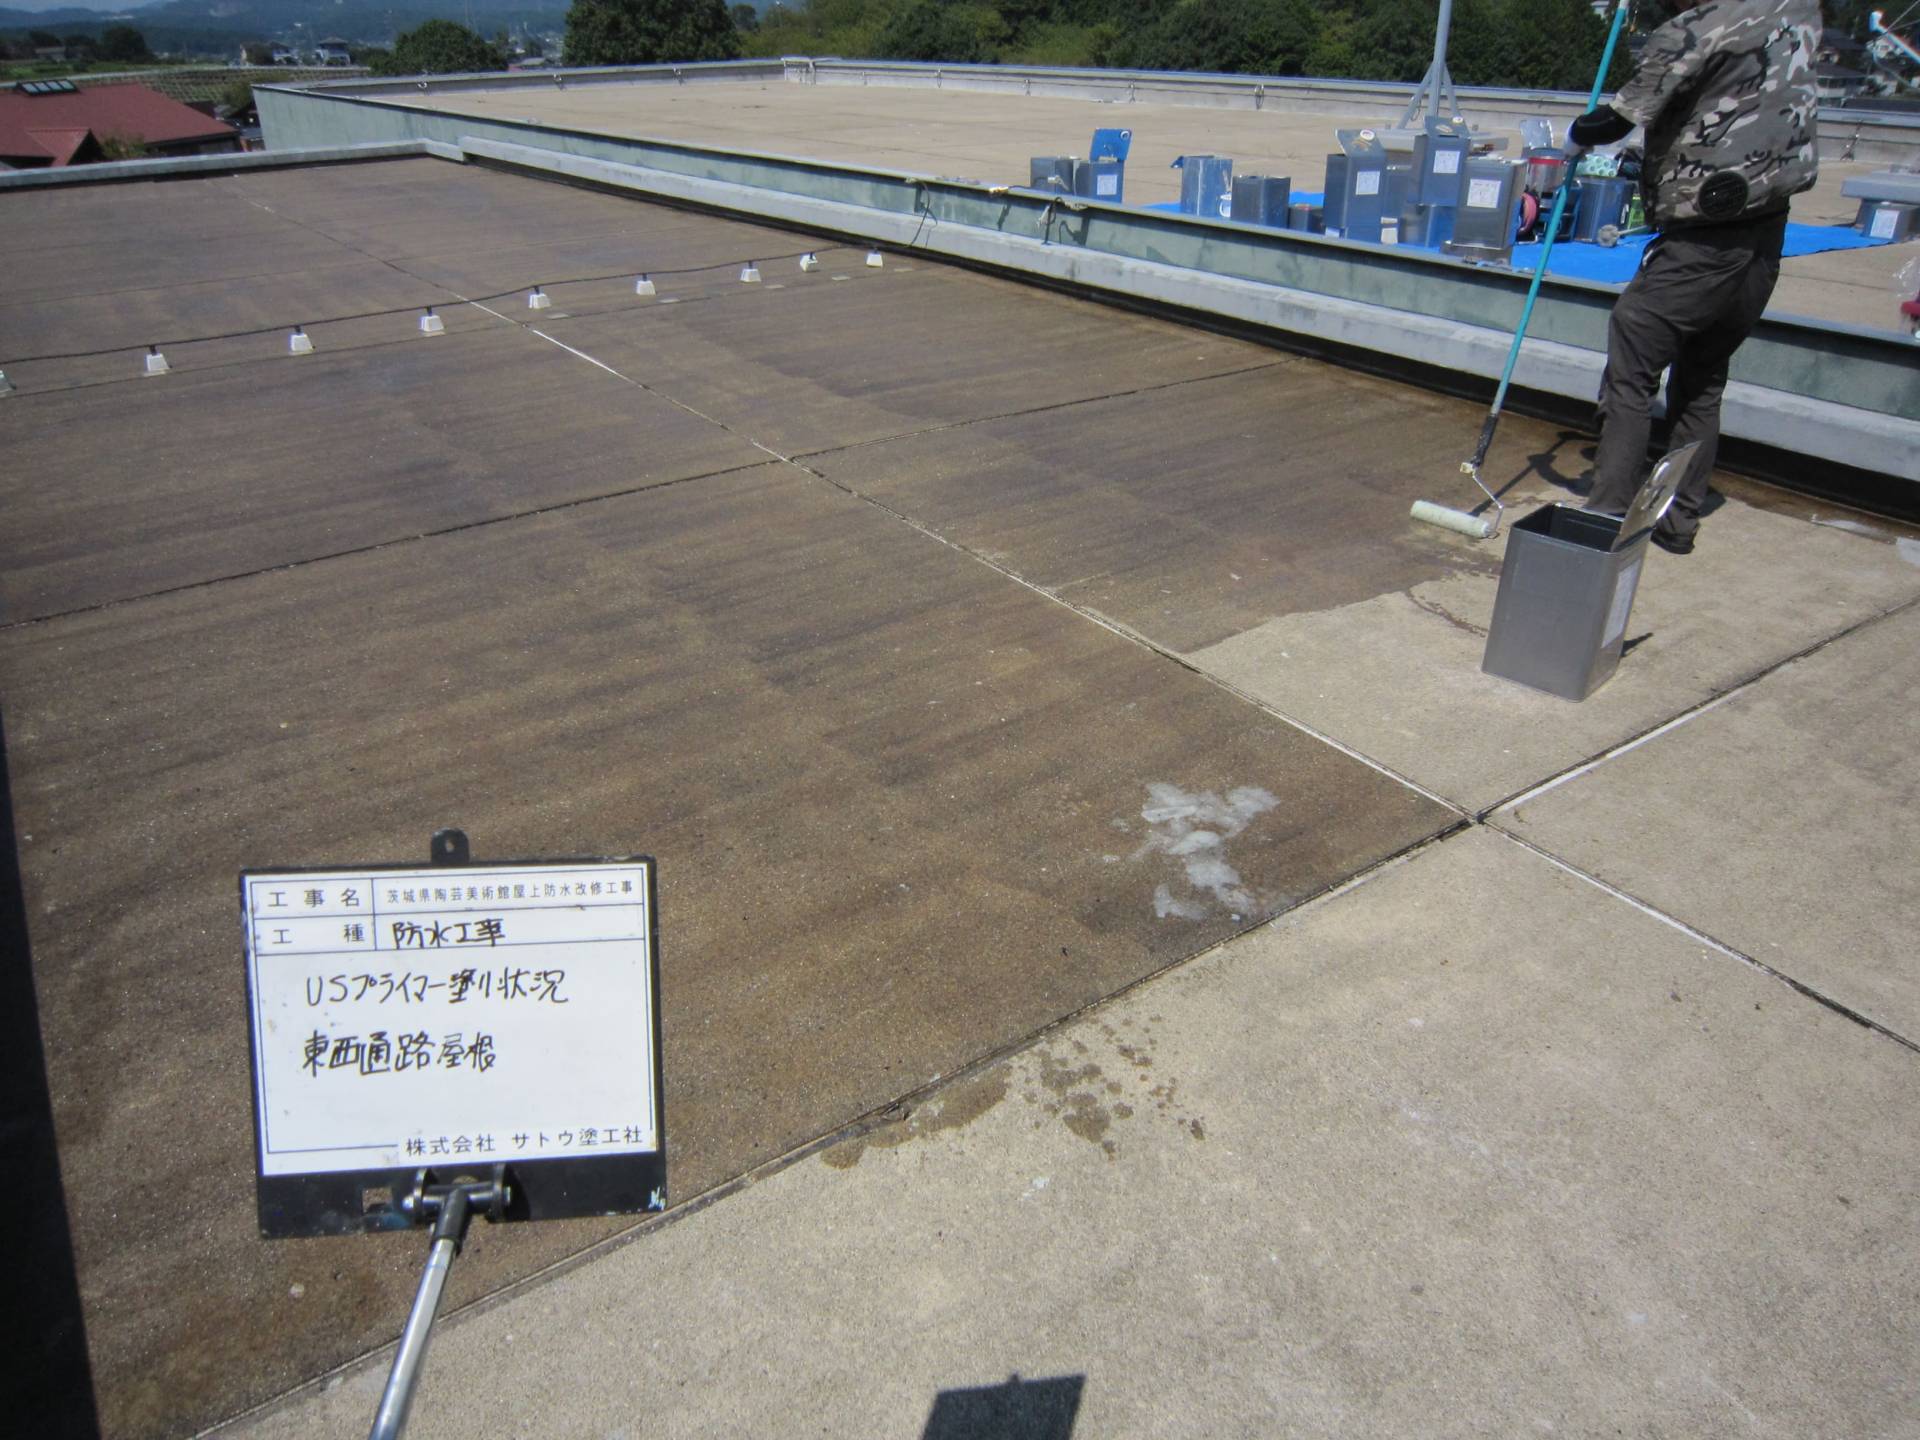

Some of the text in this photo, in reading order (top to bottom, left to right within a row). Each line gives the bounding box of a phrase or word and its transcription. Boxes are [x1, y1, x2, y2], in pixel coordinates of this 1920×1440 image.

[268, 887, 360, 907] 工事名
[387, 879, 633, 903] 茨城県陶芸美術館屋上防水改修工事
[392, 918, 506, 950] 防水工事
[306, 966, 569, 1007] USプライマー塗り状況
[302, 1029, 496, 1078] 東西通路屋根
[406, 1124, 644, 1157] 株式会社 サトウ塗工社
